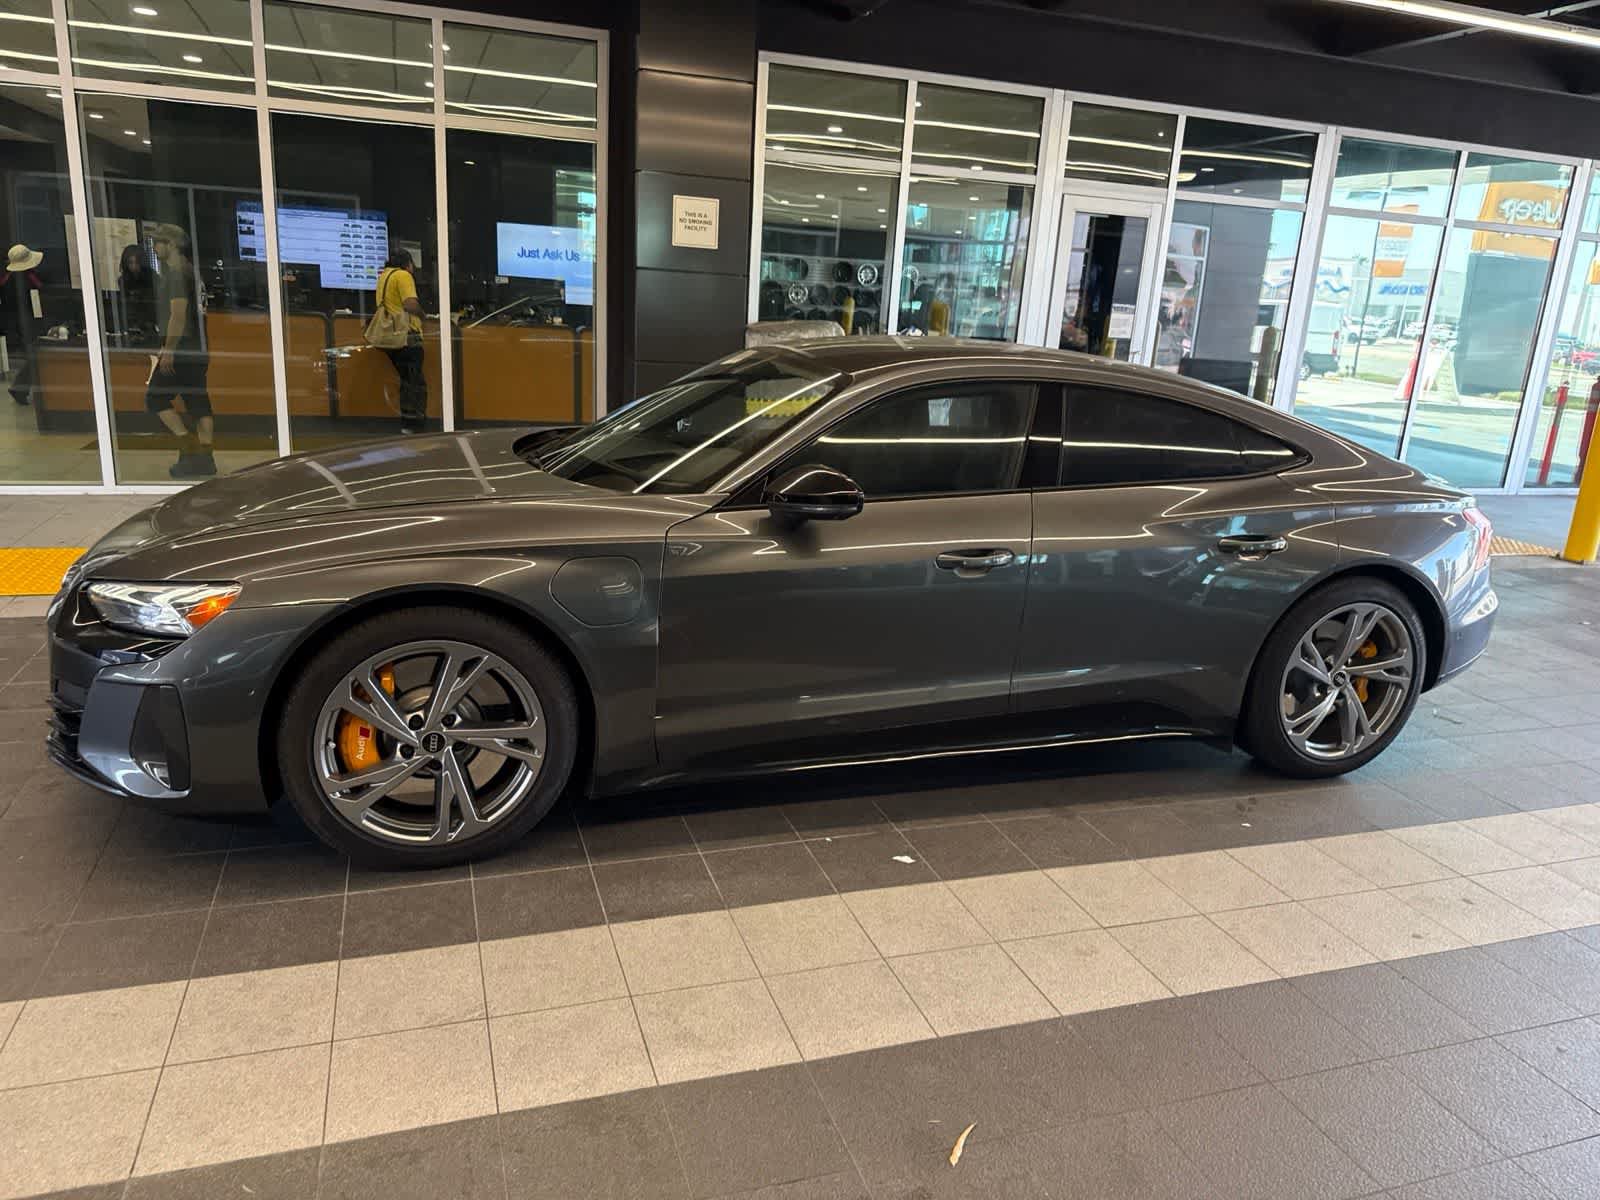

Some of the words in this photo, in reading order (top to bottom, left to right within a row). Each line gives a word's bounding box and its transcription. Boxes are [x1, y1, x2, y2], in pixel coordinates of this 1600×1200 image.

[517, 246, 540, 259] Just
[542, 248, 563, 260] Ask
[565, 249, 580, 262] Us
[355, 736, 366, 760] Audi
